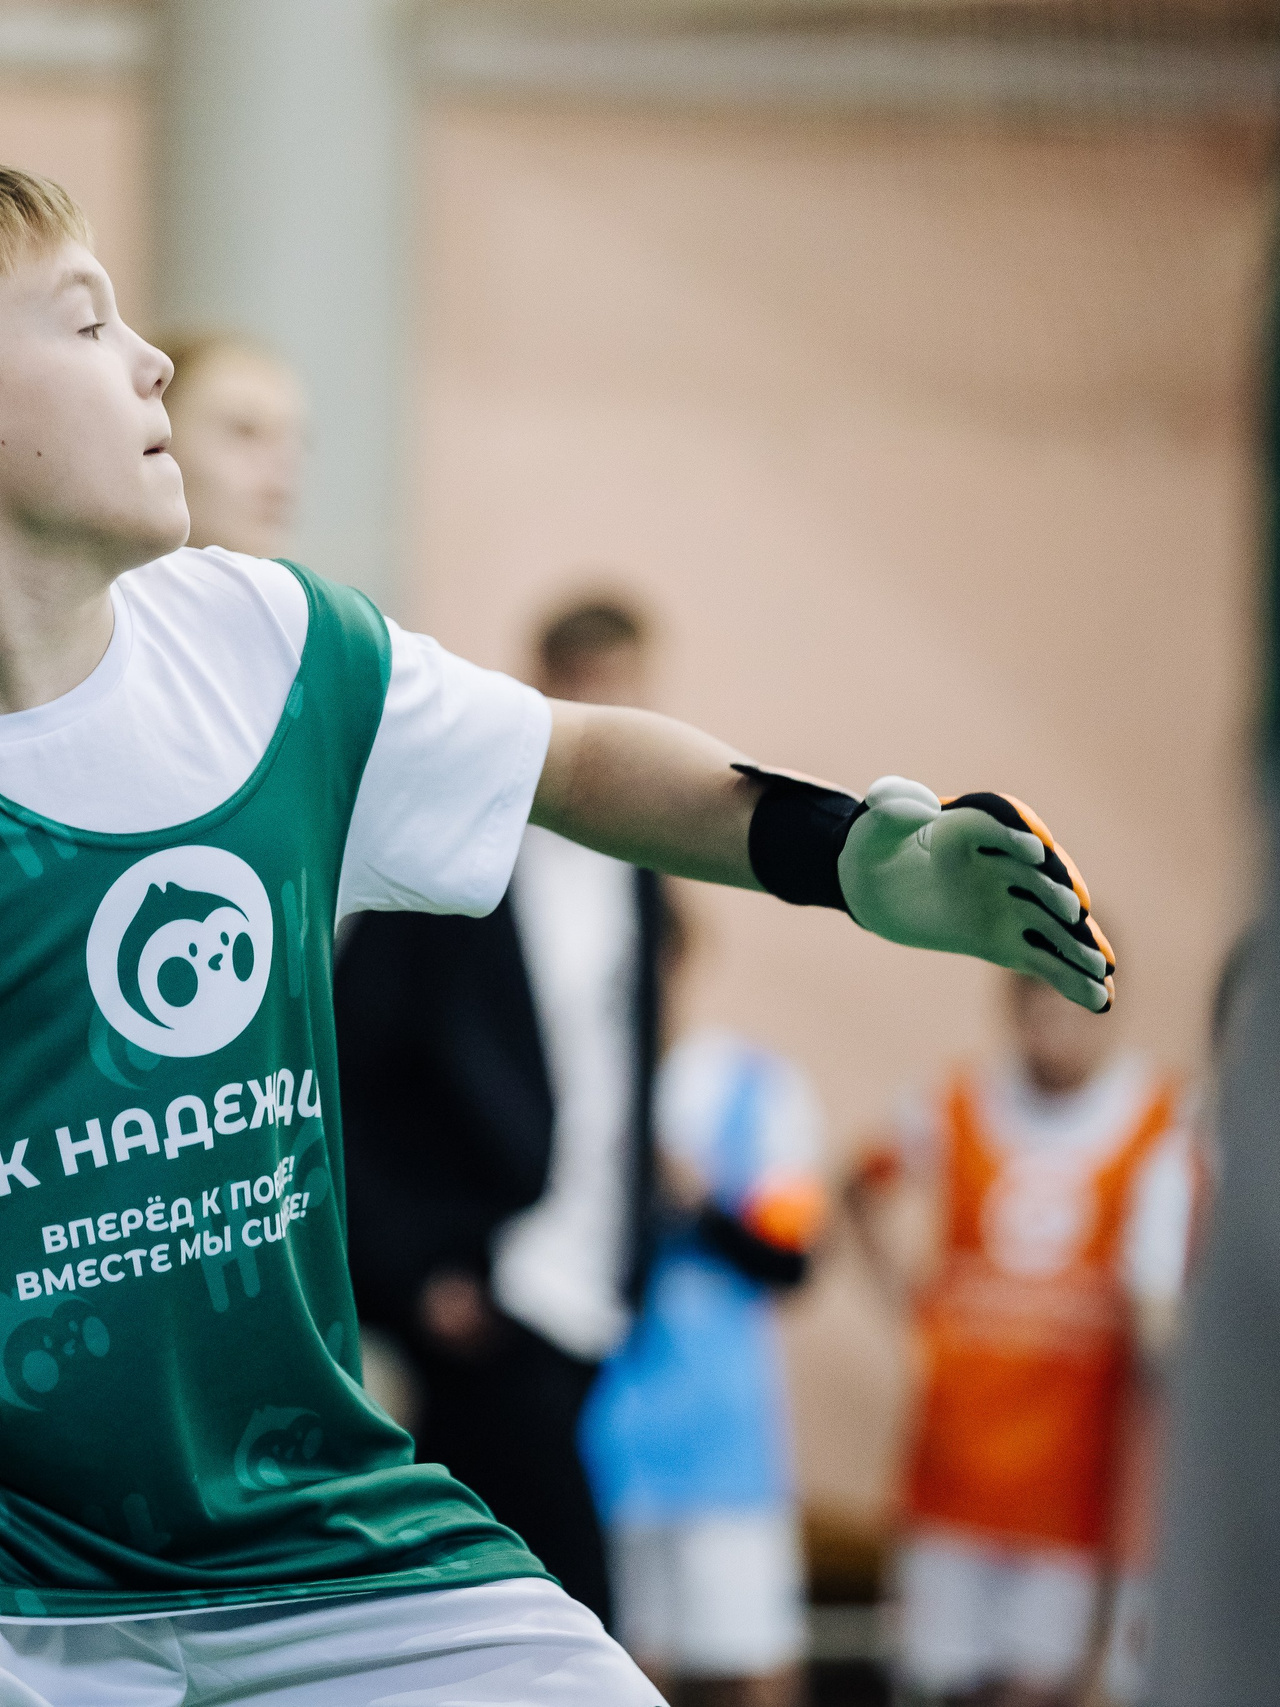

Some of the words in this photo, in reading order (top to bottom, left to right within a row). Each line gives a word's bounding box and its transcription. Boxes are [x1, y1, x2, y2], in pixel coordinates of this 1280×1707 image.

[41, 1196, 195, 1254] ВПЕРЁД
[201, 1187, 222, 1219] К
[15, 1243, 173, 1302] ВМЕСТЕ
[180, 1225, 232, 1266] МЫ
